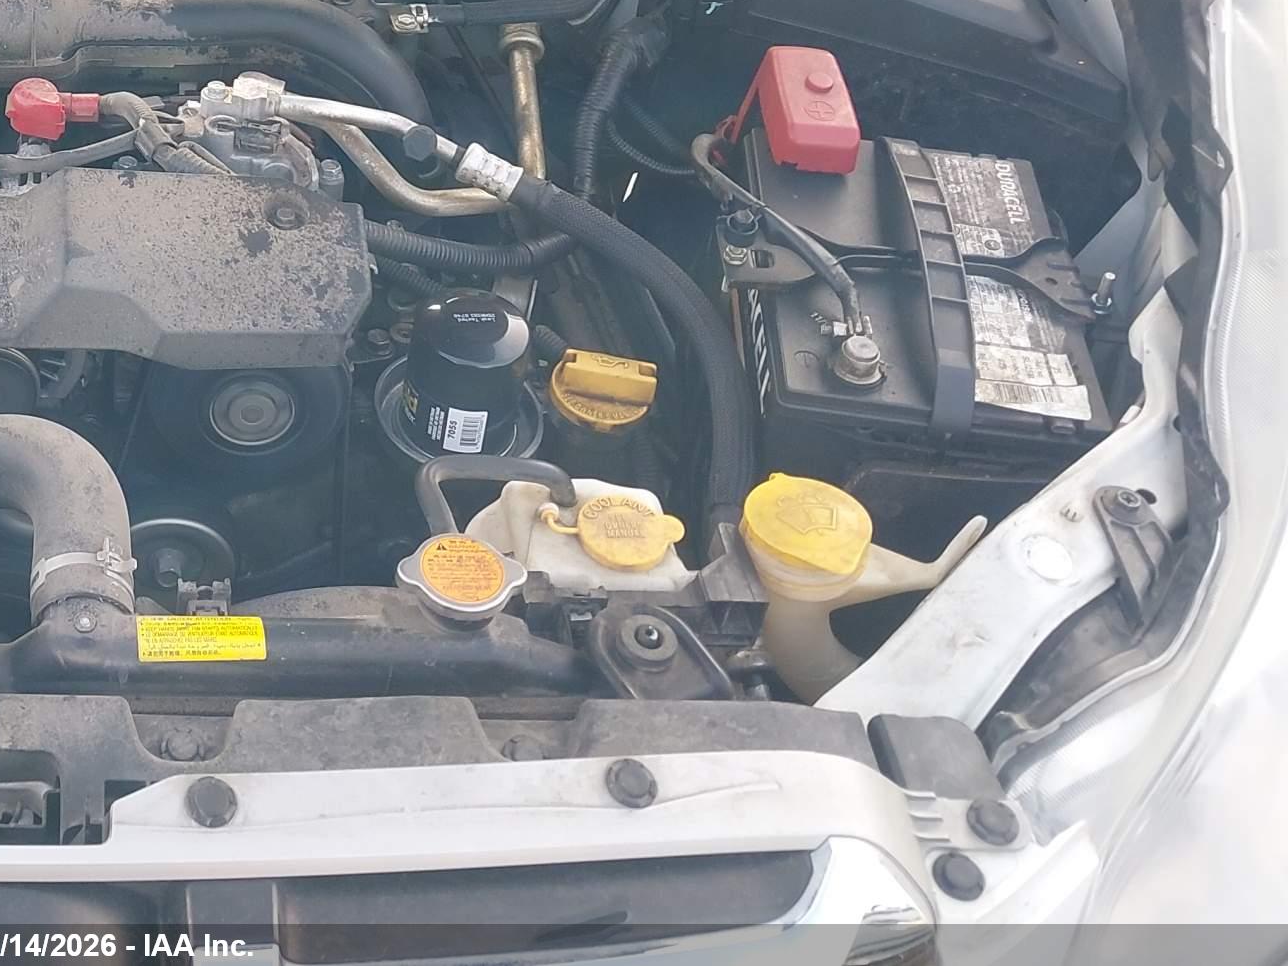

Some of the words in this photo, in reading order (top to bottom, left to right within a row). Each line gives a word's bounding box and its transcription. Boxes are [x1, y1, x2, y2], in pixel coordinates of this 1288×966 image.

[995, 163, 1025, 225] DURACELL
[747, 289, 771, 416] ACELL
[447, 420, 458, 439] 7055
[582, 497, 655, 520] COOLANT
